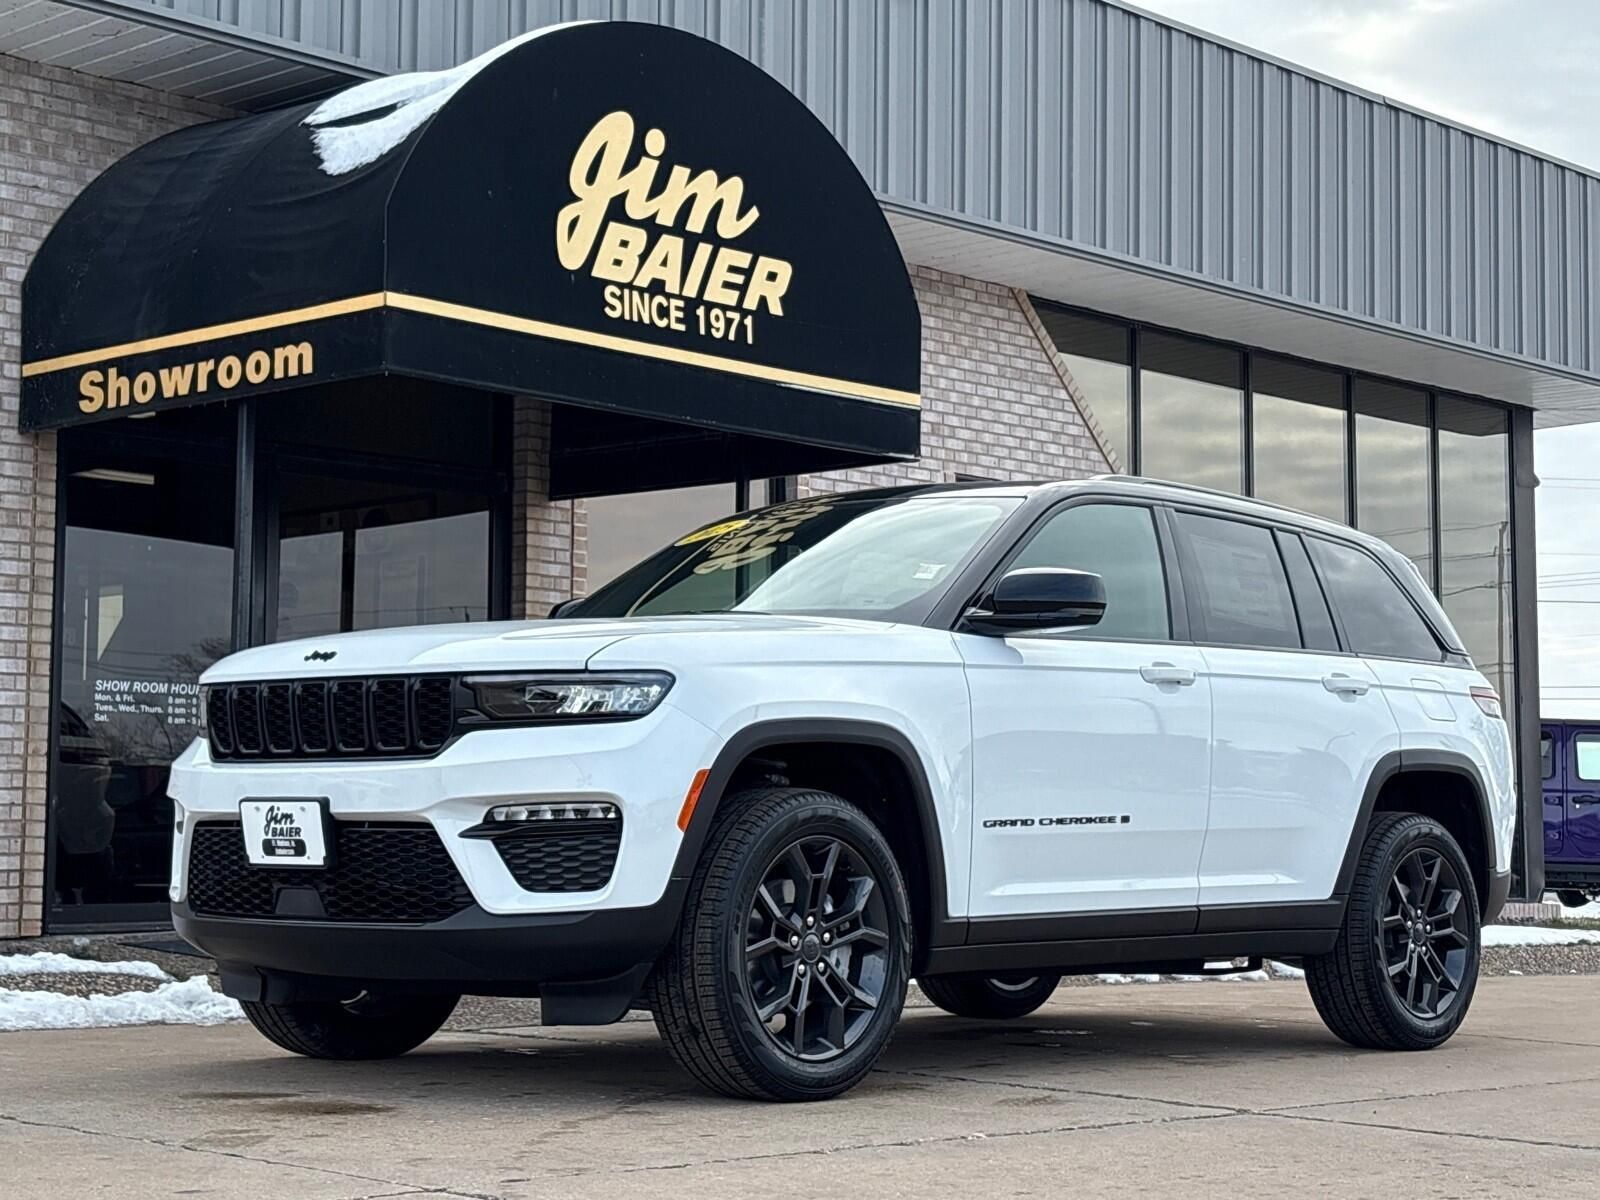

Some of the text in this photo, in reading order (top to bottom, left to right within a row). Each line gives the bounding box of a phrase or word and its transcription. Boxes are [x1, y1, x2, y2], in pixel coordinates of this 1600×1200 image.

[557, 111, 760, 271] Jim
[591, 221, 792, 316] BAIER
[604, 285, 753, 344] SINCE 1971
[79, 341, 313, 413] Showroom
[95, 680, 130, 692] SHOW
[133, 681, 168, 693] ROOM
[94, 693, 113, 702] Mon.
[115, 694, 121, 702] &
[123, 694, 135, 702] Fri.
[140, 705, 164, 713] Thurs.
[94, 713, 109, 722] Sat.
[264, 805, 295, 837] Jim
[983, 815, 1117, 828] GRAND CHEROKEE
[271, 827, 302, 838] BAIER
